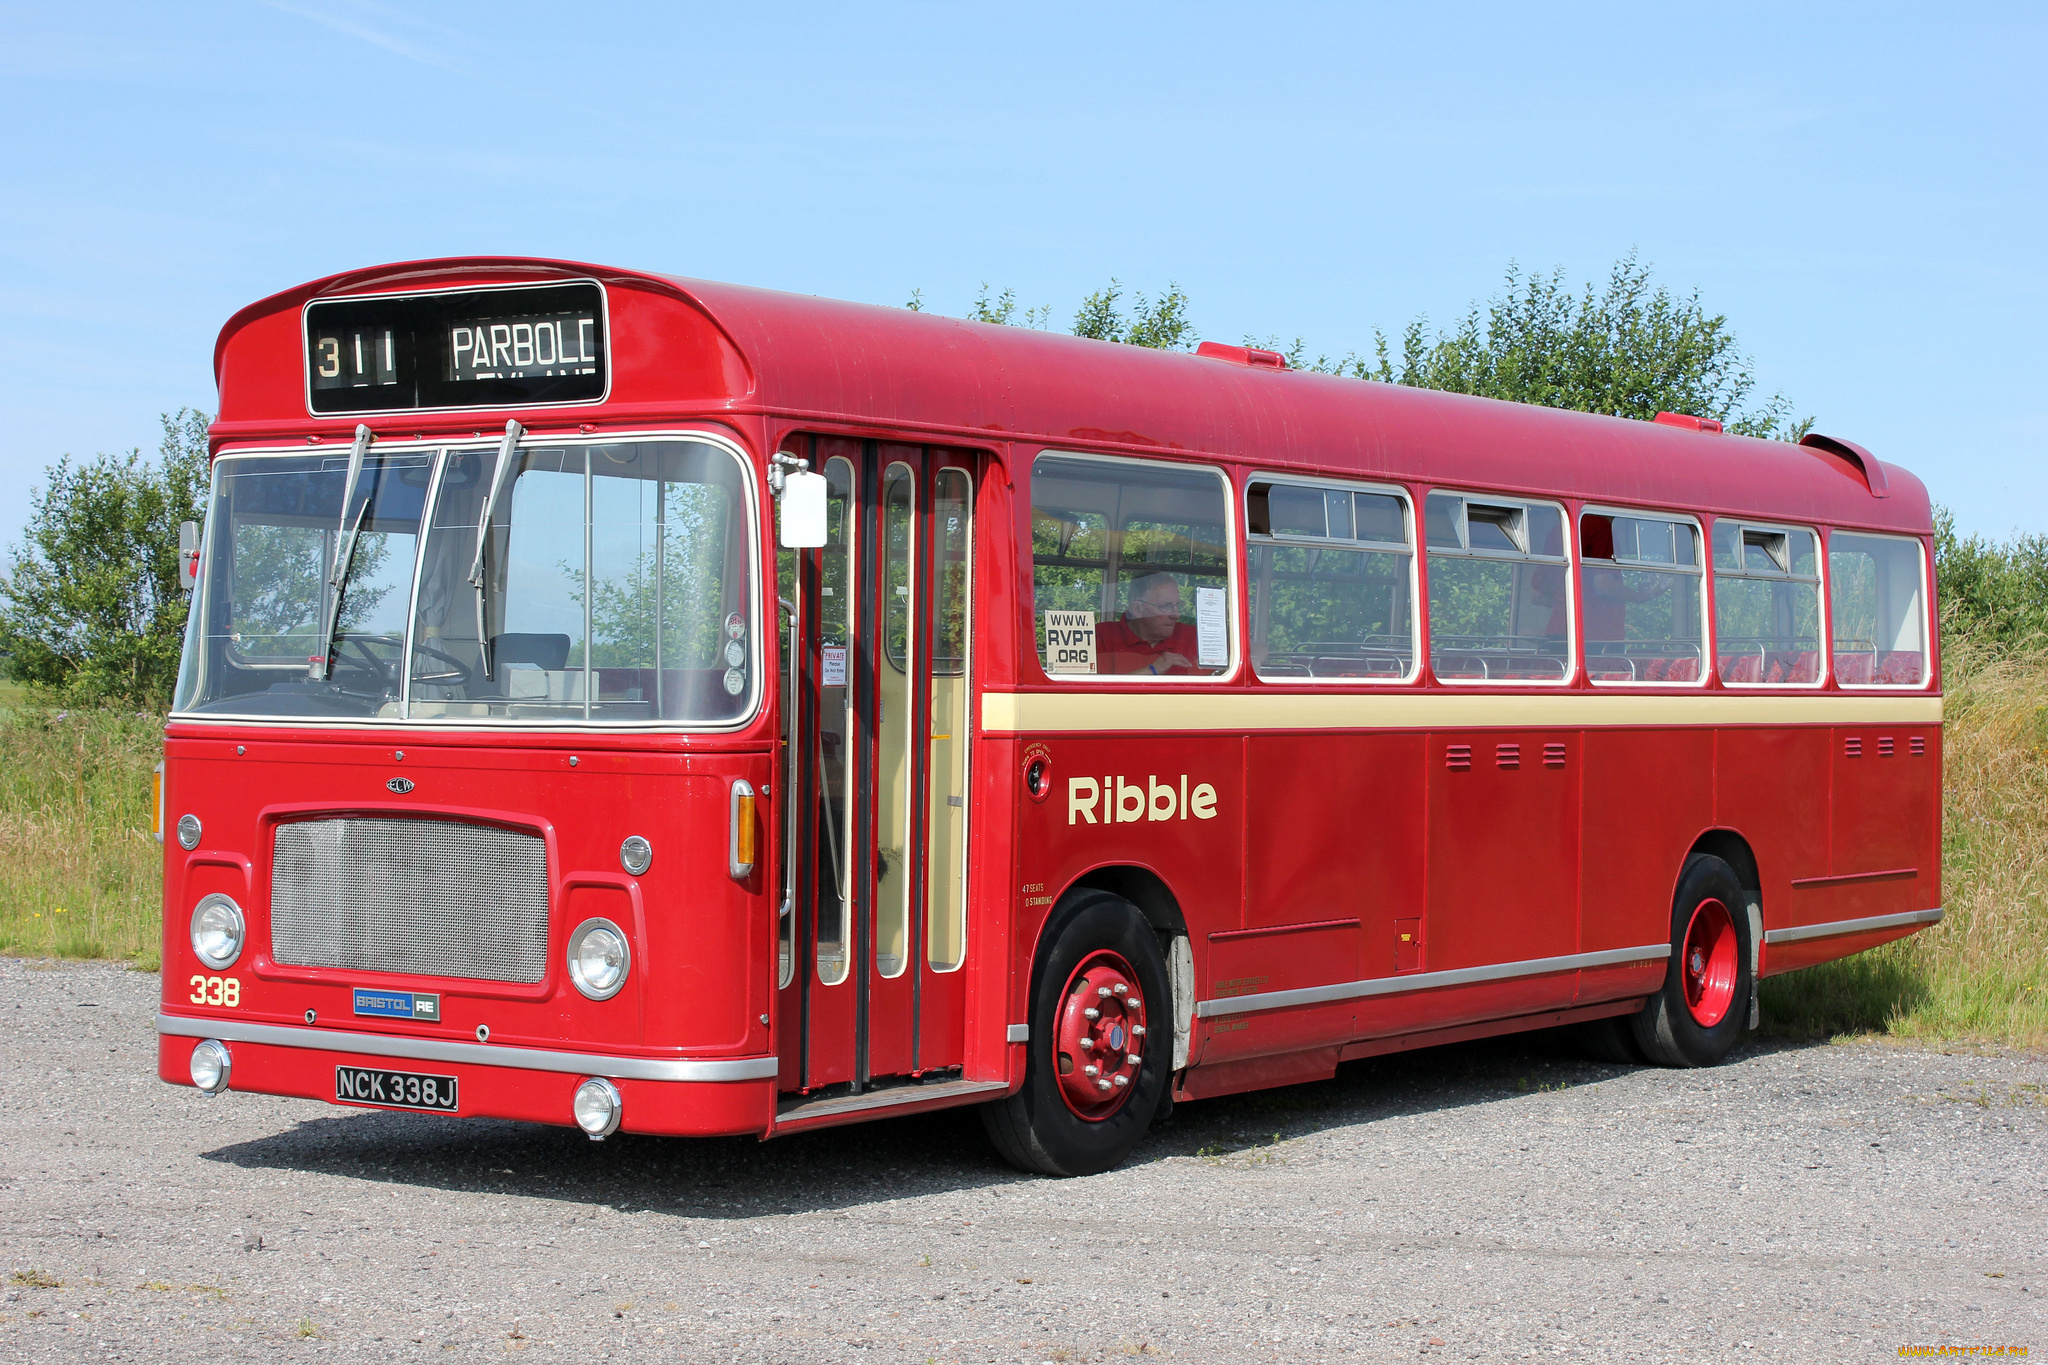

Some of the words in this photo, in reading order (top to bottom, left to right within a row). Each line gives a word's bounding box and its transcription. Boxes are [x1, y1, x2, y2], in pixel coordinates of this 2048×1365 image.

[1050, 614, 1088, 627] WWW.
[1047, 629, 1094, 646] RVPT
[1055, 649, 1089, 663] .ORG
[388, 779, 412, 791] ECW
[1068, 774, 1218, 826] Ribble
[1022, 884, 1029, 893] 47
[1030, 883, 1044, 892] SEATS
[1030, 895, 1053, 906] STANDING
[190, 974, 241, 1008] 338
[356, 995, 411, 1011] BRISTOL
[416, 1000, 434, 1013] RE
[340, 1069, 386, 1101] NCK
[390, 1075, 454, 1107] 338J
